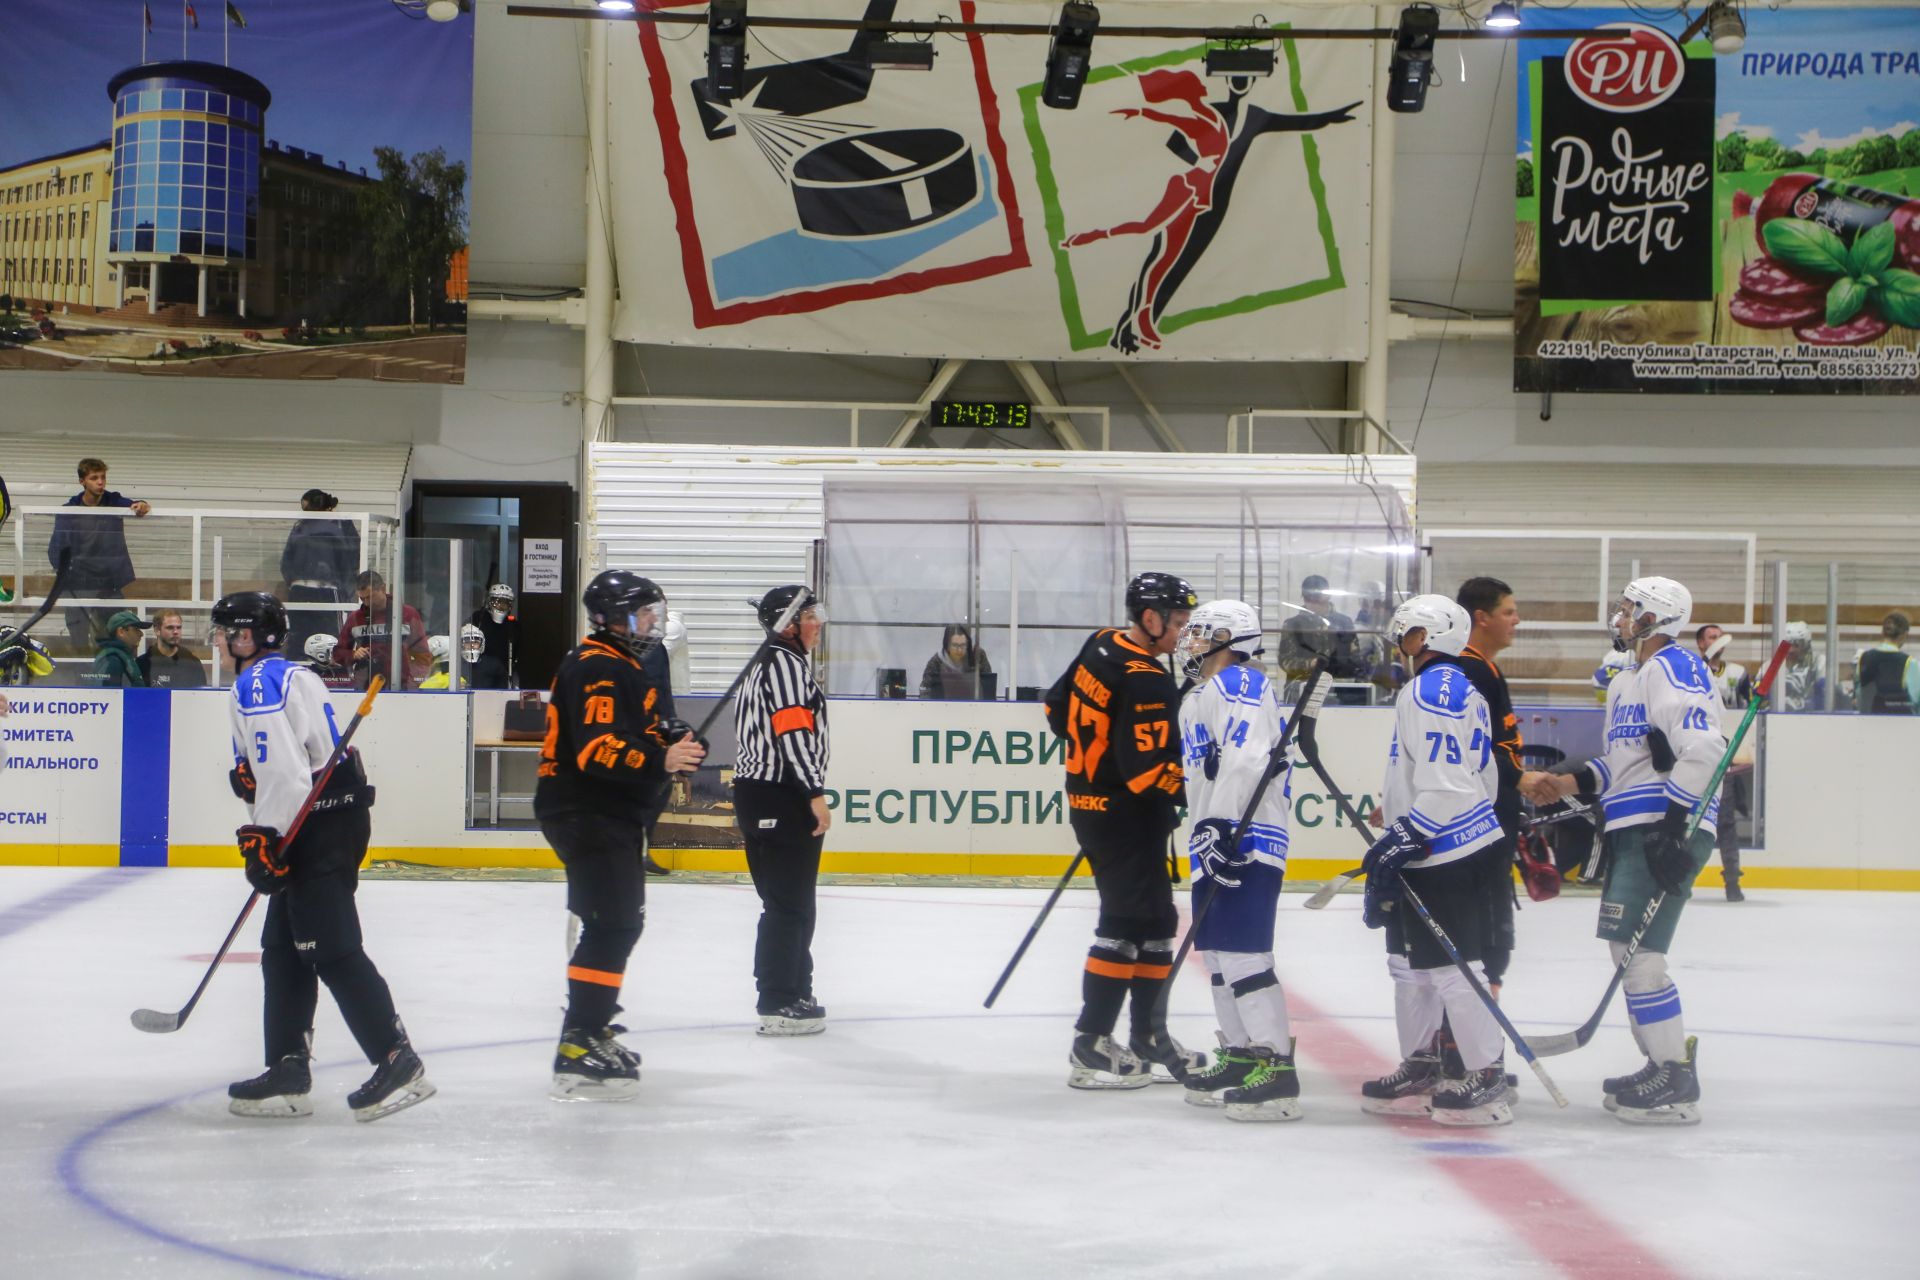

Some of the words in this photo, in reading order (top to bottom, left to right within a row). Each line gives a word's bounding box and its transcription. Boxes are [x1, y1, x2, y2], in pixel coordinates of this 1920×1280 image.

[1741, 52, 1864, 80] ПРИРОДА
[1550, 126, 1709, 225] Родные
[1538, 342, 1596, 361] 422191,
[1600, 342, 1691, 362] Республика
[1695, 343, 1778, 362] Татарстан,
[1782, 350, 1793, 359] г.
[1796, 345, 1882, 363] Мамадыш,
[1785, 364, 1816, 377] тел.
[1818, 362, 1918, 377] 88556335273
[34, 702, 44, 714] И
[48, 702, 110, 715] СПОРТУ
[255, 731, 267, 763] 6
[1133, 720, 1169, 752] 57
[1425, 732, 1462, 764] 79
